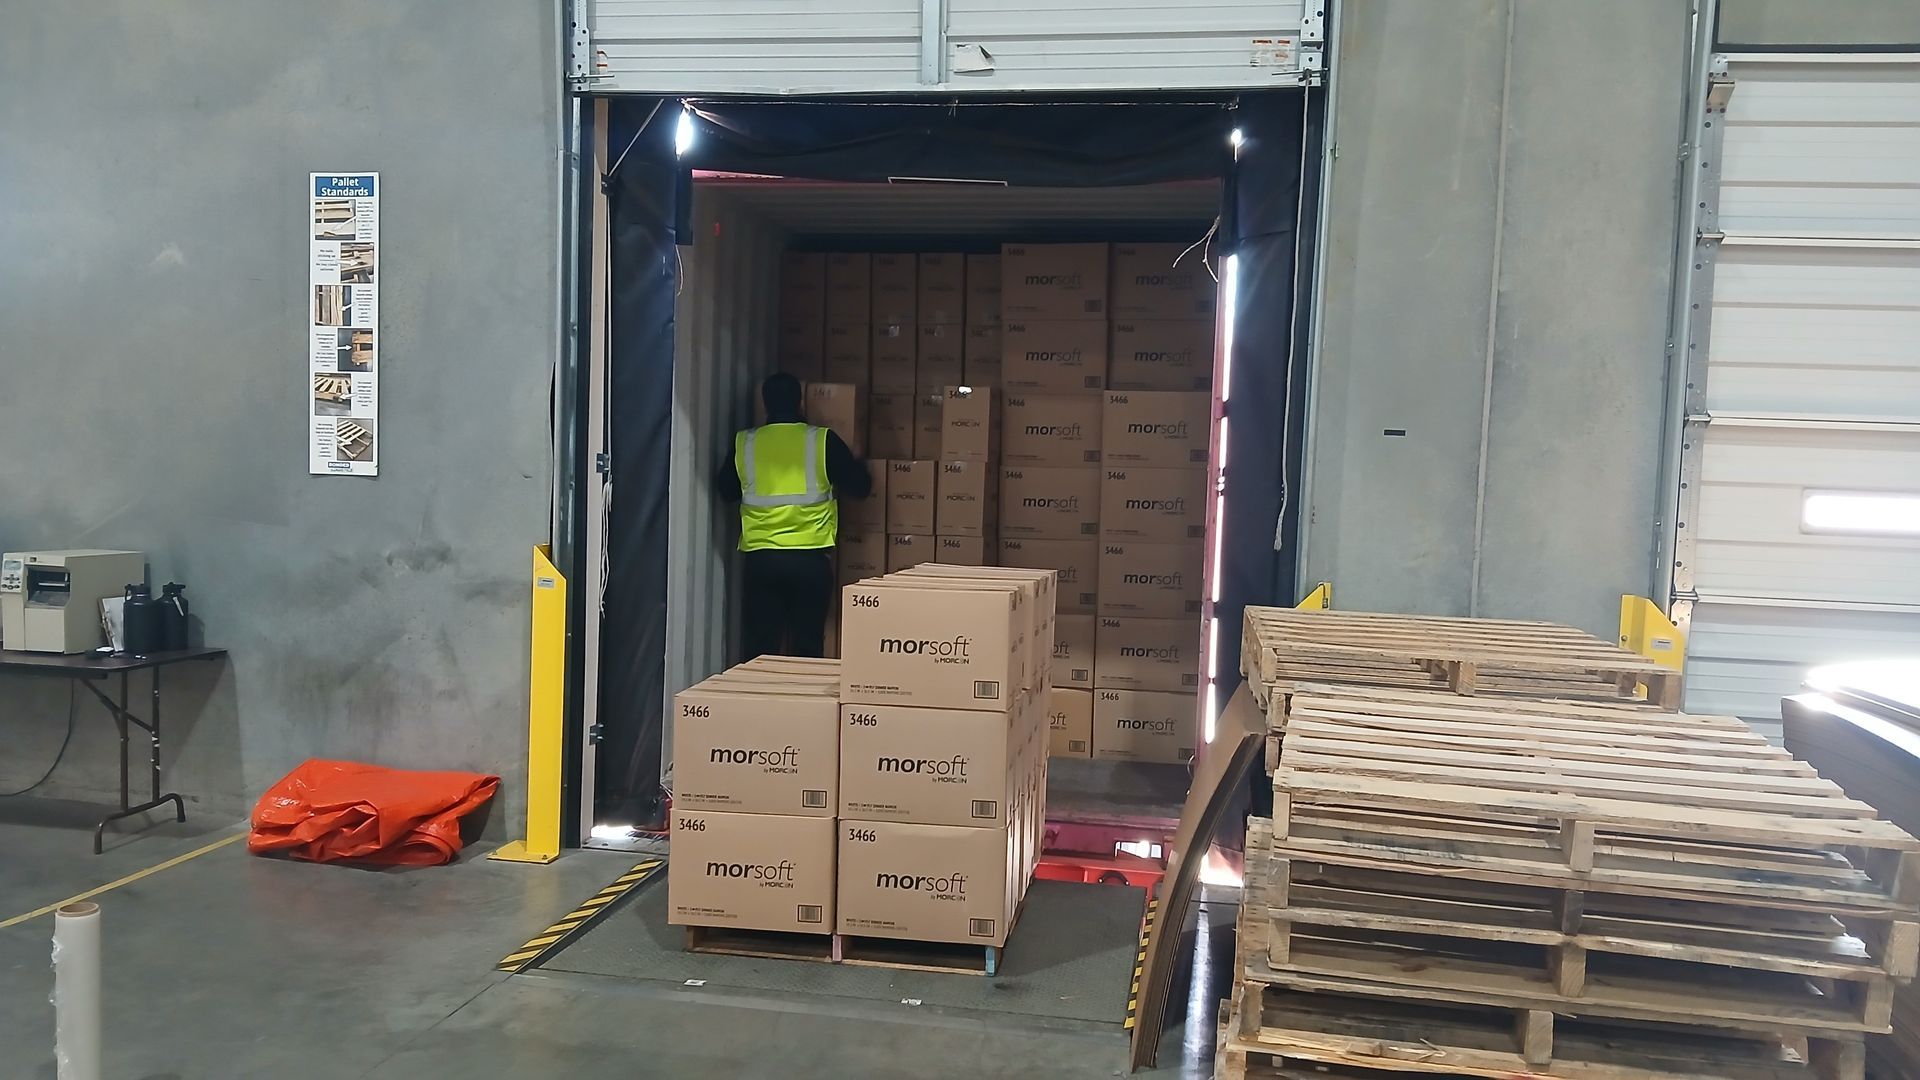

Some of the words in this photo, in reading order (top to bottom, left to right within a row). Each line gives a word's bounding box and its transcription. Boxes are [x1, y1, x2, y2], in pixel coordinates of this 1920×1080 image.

[332, 178, 358, 186] Pallet
[322, 188, 368, 196] Standards
[1025, 273, 1081, 286] morsoft
[1025, 349, 1082, 361] morsoft
[1134, 349, 1192, 362] morsoft
[949, 391, 969, 399] 34
[1110, 396, 1128, 404] 3466
[1008, 399, 1025, 407] 3466
[1025, 423, 1082, 436] morsoft
[1128, 421, 1188, 434] morsoft
[894, 464, 911, 472] 3466
[944, 465, 961, 474] 3466
[1005, 471, 1023, 479] 3466
[1107, 472, 1126, 480] 3466
[1023, 496, 1079, 509] morsoft
[1126, 497, 1185, 511] morsoft
[895, 537, 912, 546] 3466
[943, 540, 960, 548] 3466
[1105, 547, 1123, 555] 3466
[1124, 572, 1183, 586] morsoft
[852, 595, 879, 608] 3466
[1102, 619, 1120, 628] 3466
[879, 635, 970, 657] morsoft
[1120, 645, 1180, 659] morsoft
[1101, 693, 1119, 701] 3466
[683, 705, 709, 717] 3466
[850, 713, 877, 726] 3466
[1117, 718, 1175, 731] morsoft
[710, 746, 797, 766] morsoft
[877, 755, 967, 776] morsoft
[679, 818, 705, 831] 3466
[849, 829, 876, 842] 3466
[707, 860, 793, 880] morsoft
[876, 873, 965, 893] morsoft
